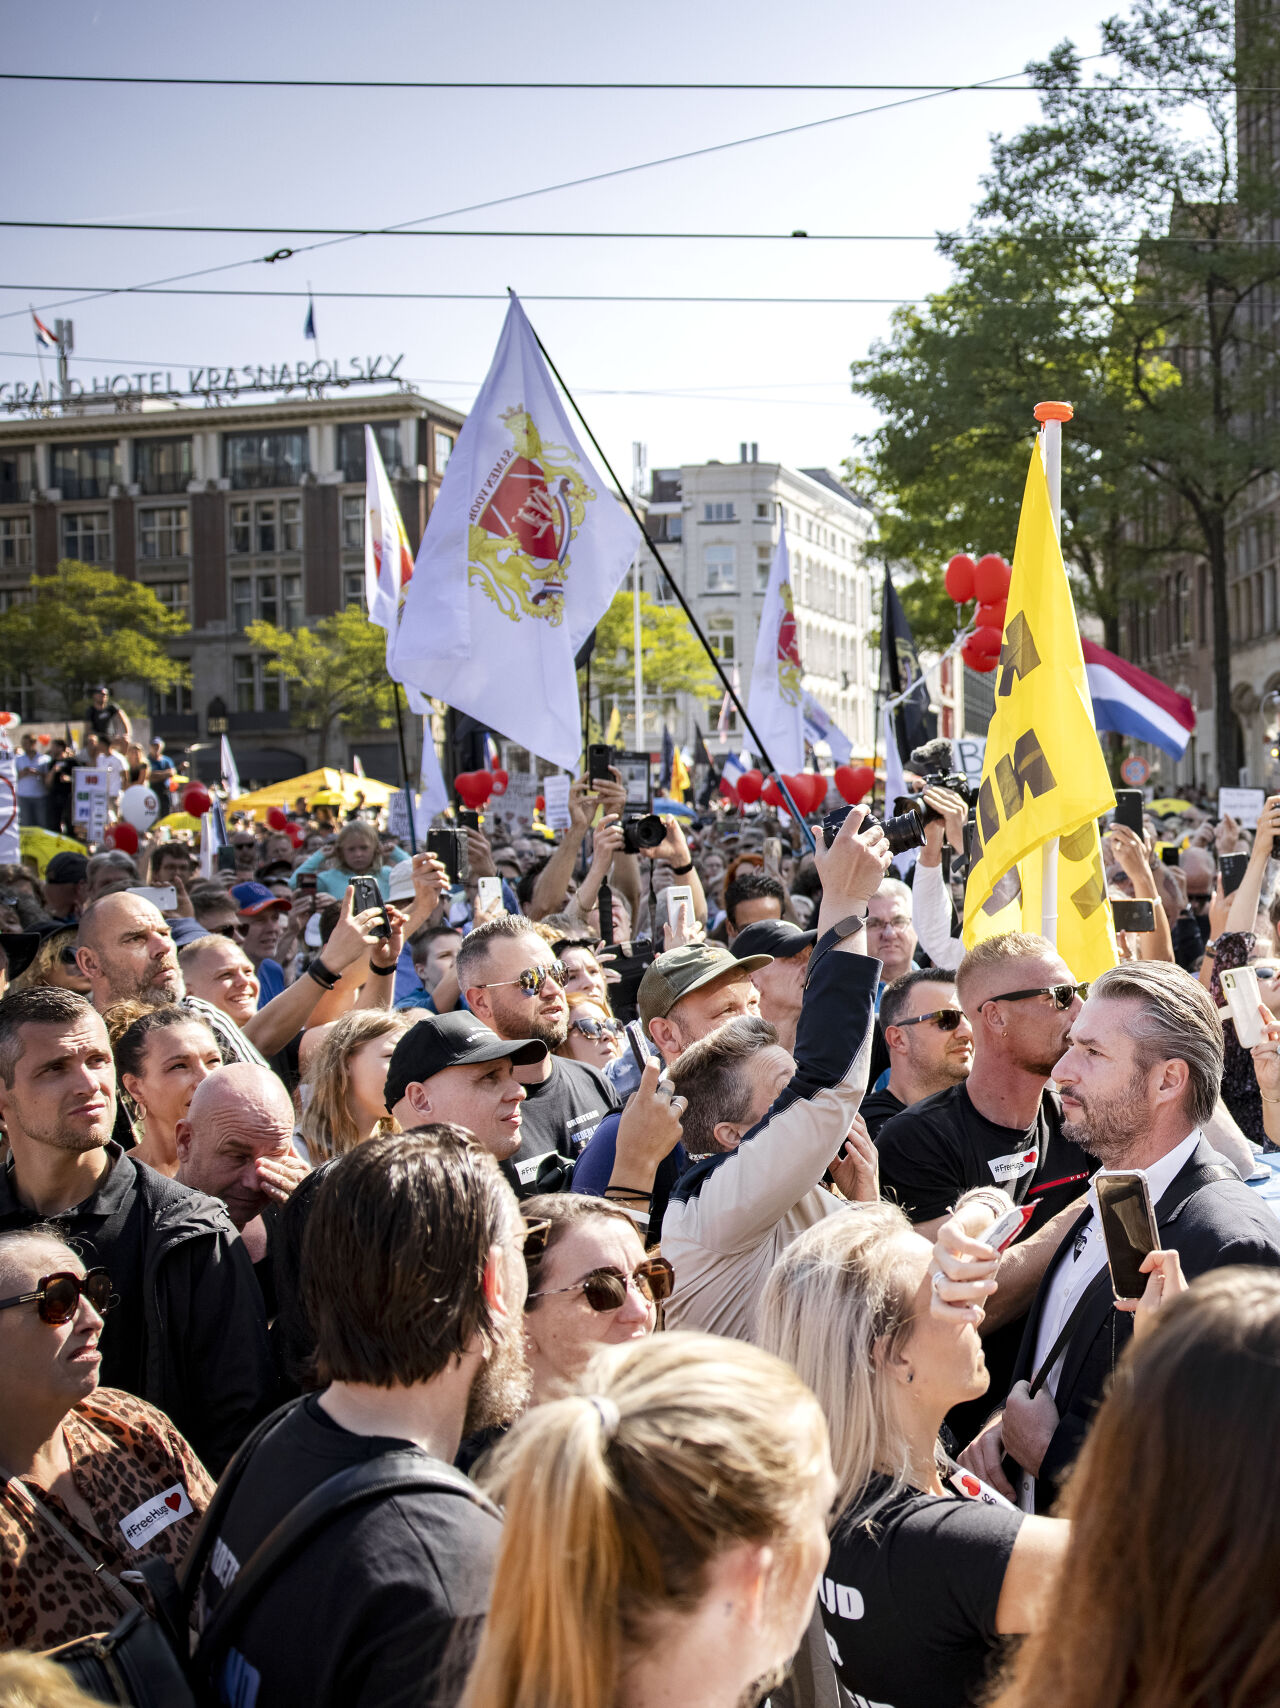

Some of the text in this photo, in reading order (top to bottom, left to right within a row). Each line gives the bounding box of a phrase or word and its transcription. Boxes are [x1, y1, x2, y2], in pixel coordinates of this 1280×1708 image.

[0, 353, 404, 402] GRAND HOTEL KRASNAPOLSKY
[126, 1505, 169, 1539] #FreeHugs
[817, 1576, 865, 1620] UD
